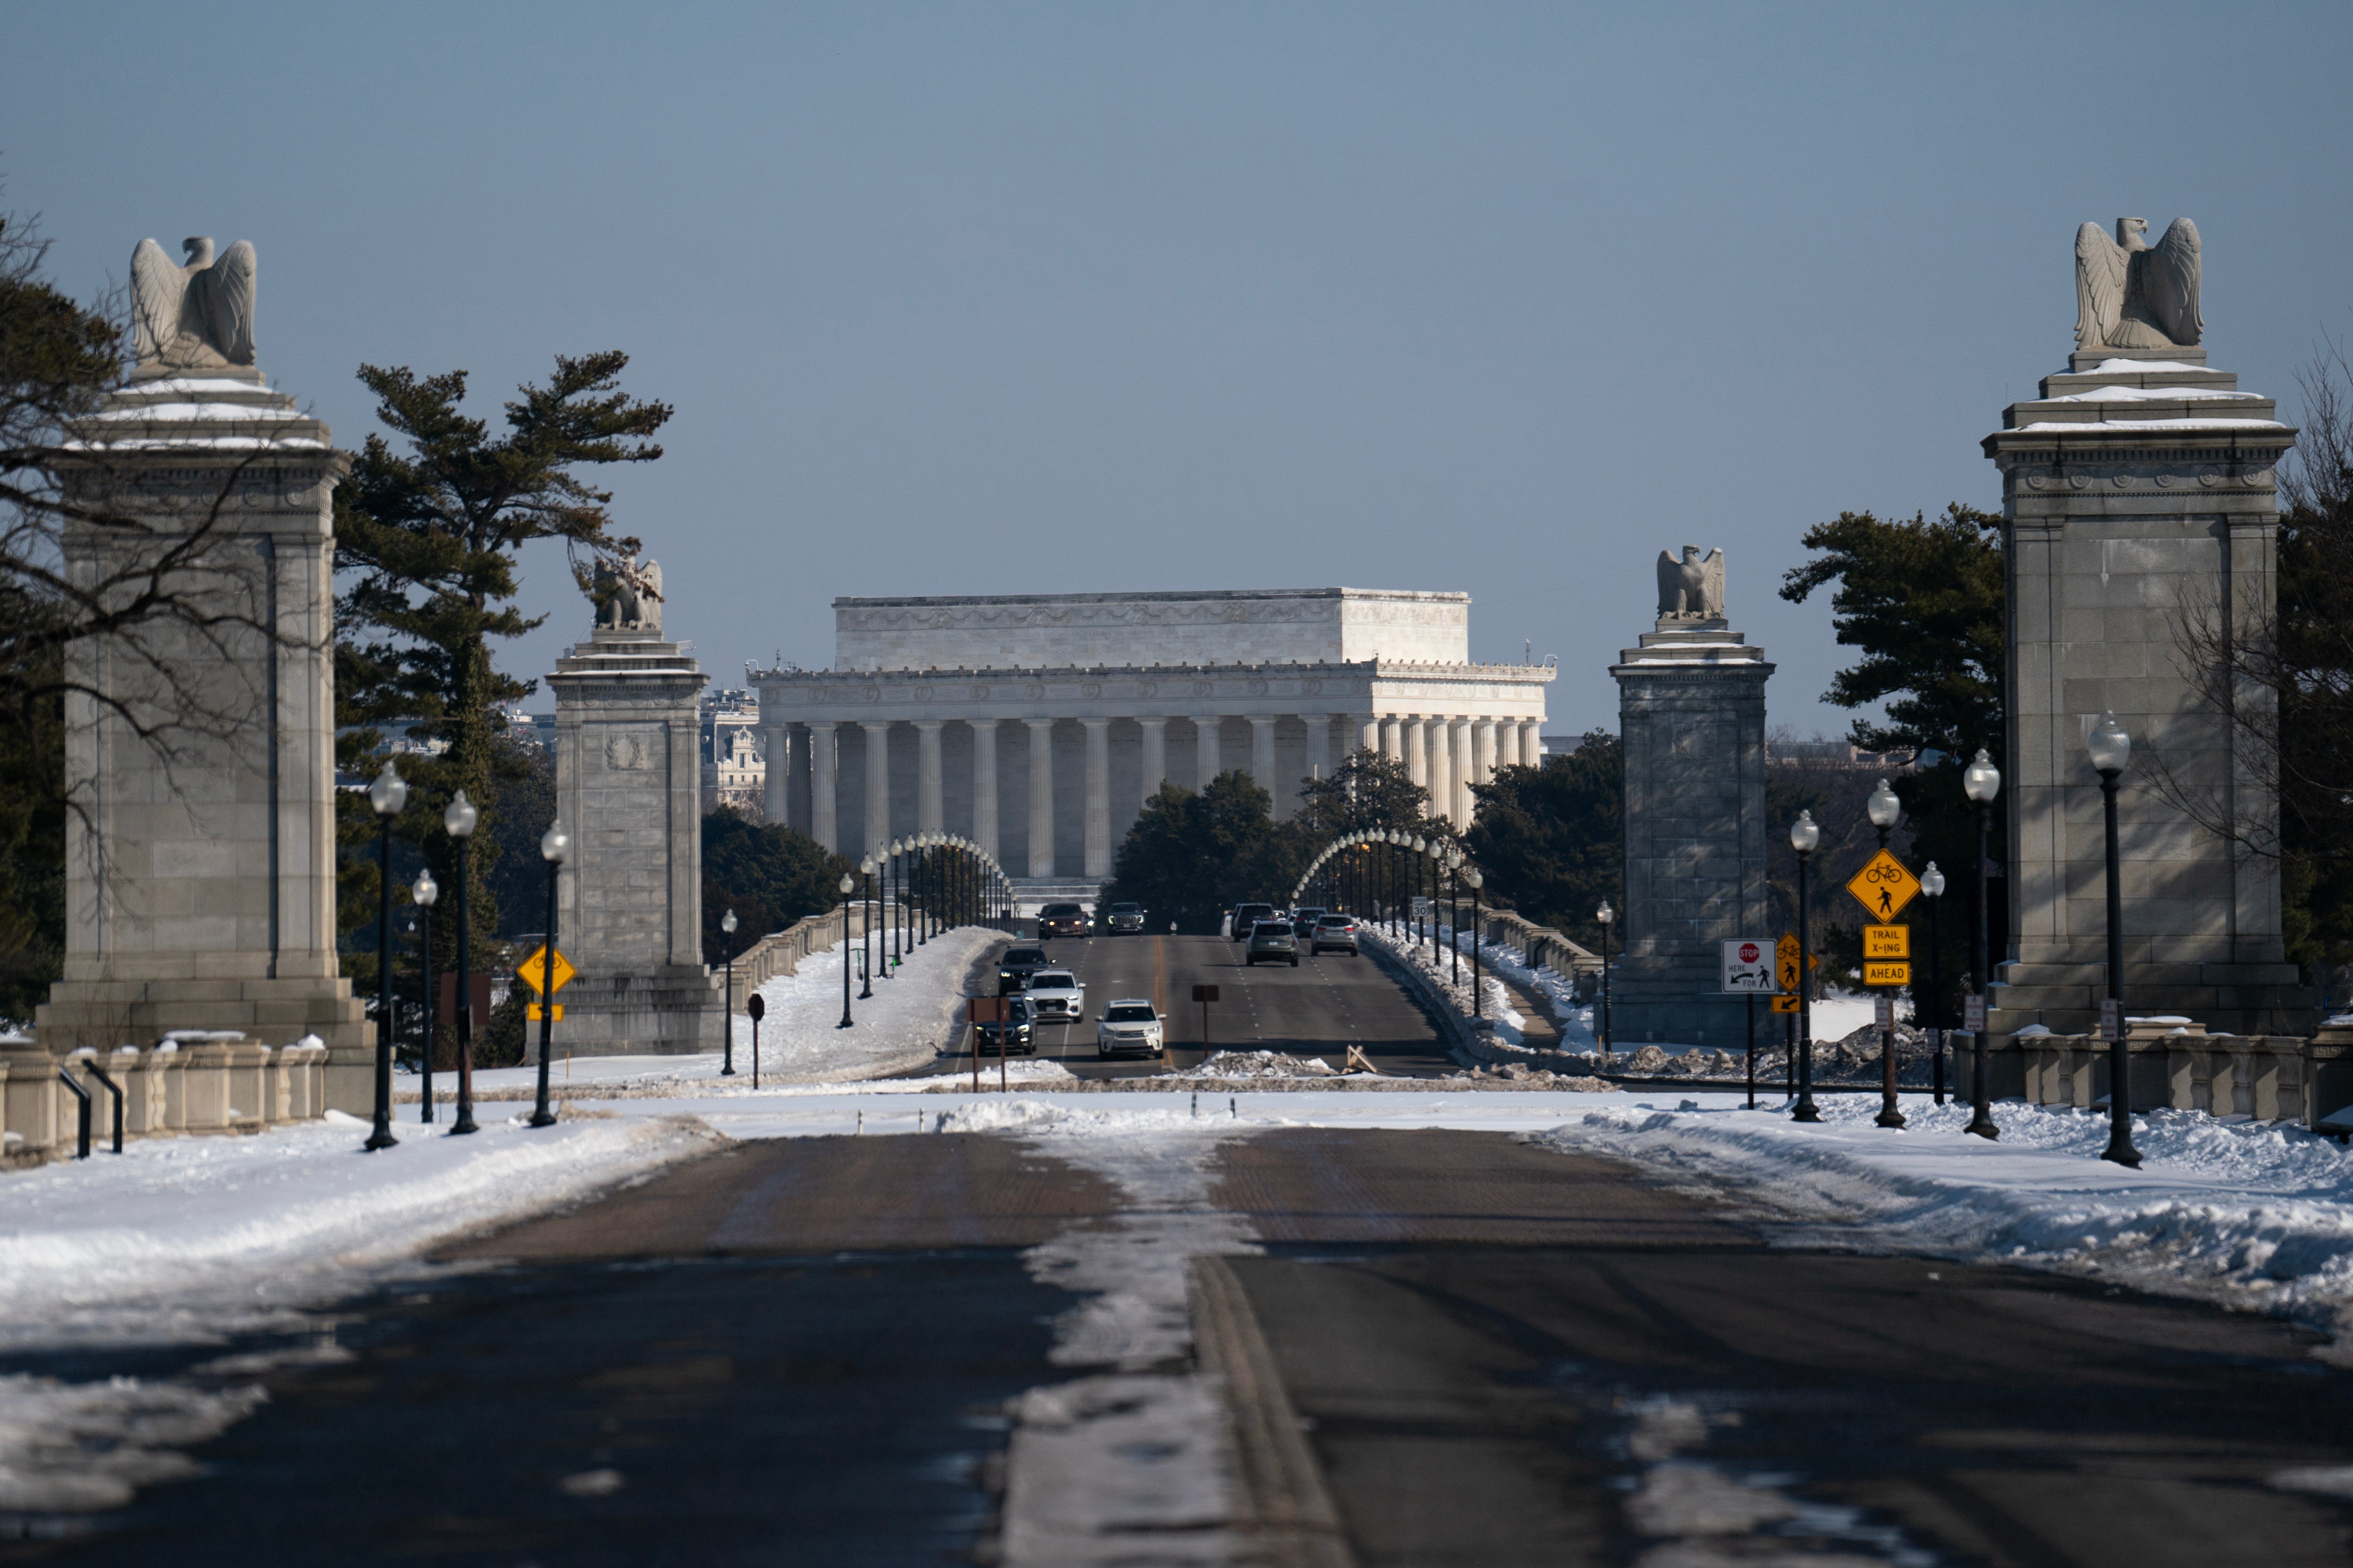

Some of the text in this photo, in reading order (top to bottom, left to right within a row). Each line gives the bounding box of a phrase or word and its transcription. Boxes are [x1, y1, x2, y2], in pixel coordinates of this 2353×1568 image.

[1872, 930, 1899, 939] TRAIL
[1872, 944, 1900, 952] X-ING
[1739, 949, 1759, 958] STOP
[1870, 968, 1904, 978] AHEAD
